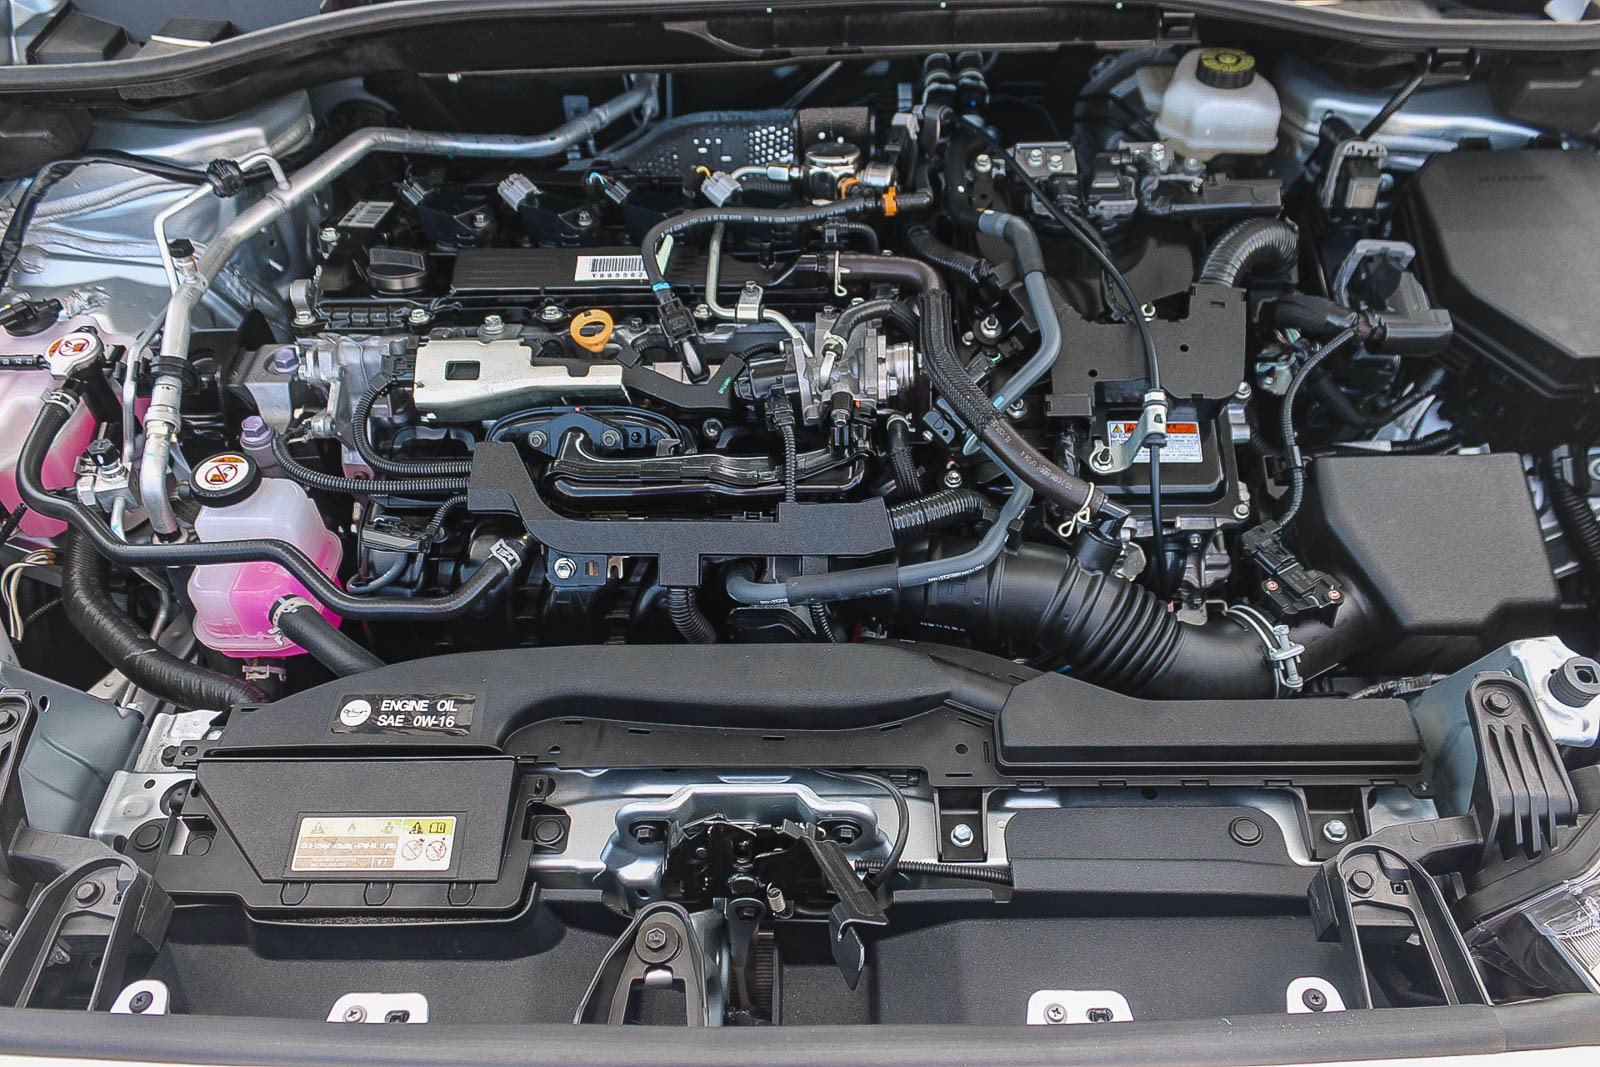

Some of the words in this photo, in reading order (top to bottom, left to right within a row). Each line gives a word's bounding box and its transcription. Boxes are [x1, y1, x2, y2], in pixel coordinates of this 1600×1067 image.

[380, 699, 429, 711] ENGINE
[436, 699, 458, 712] OIL
[376, 715, 405, 726] SAE
[413, 715, 455, 727] 0W-16
